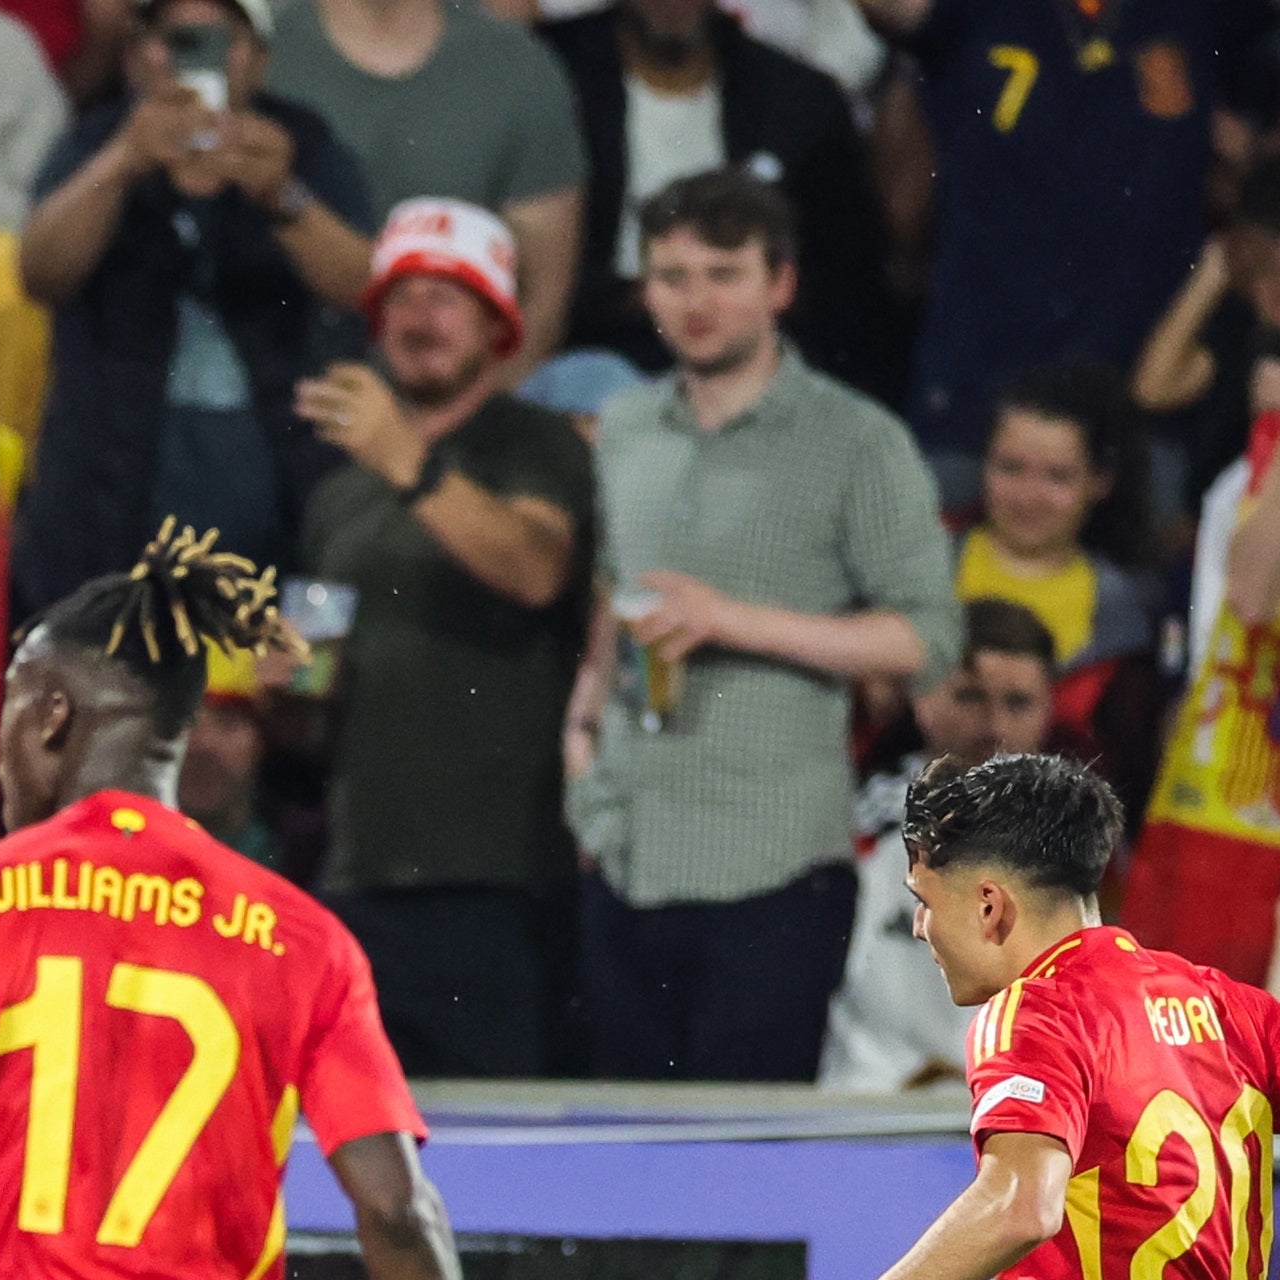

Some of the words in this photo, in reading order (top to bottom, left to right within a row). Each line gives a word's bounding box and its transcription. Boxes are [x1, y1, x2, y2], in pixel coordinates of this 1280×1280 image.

[987, 46, 1040, 134] 7
[212, 893, 287, 956] JR.
[1143, 995, 1226, 1046] PEDRI
